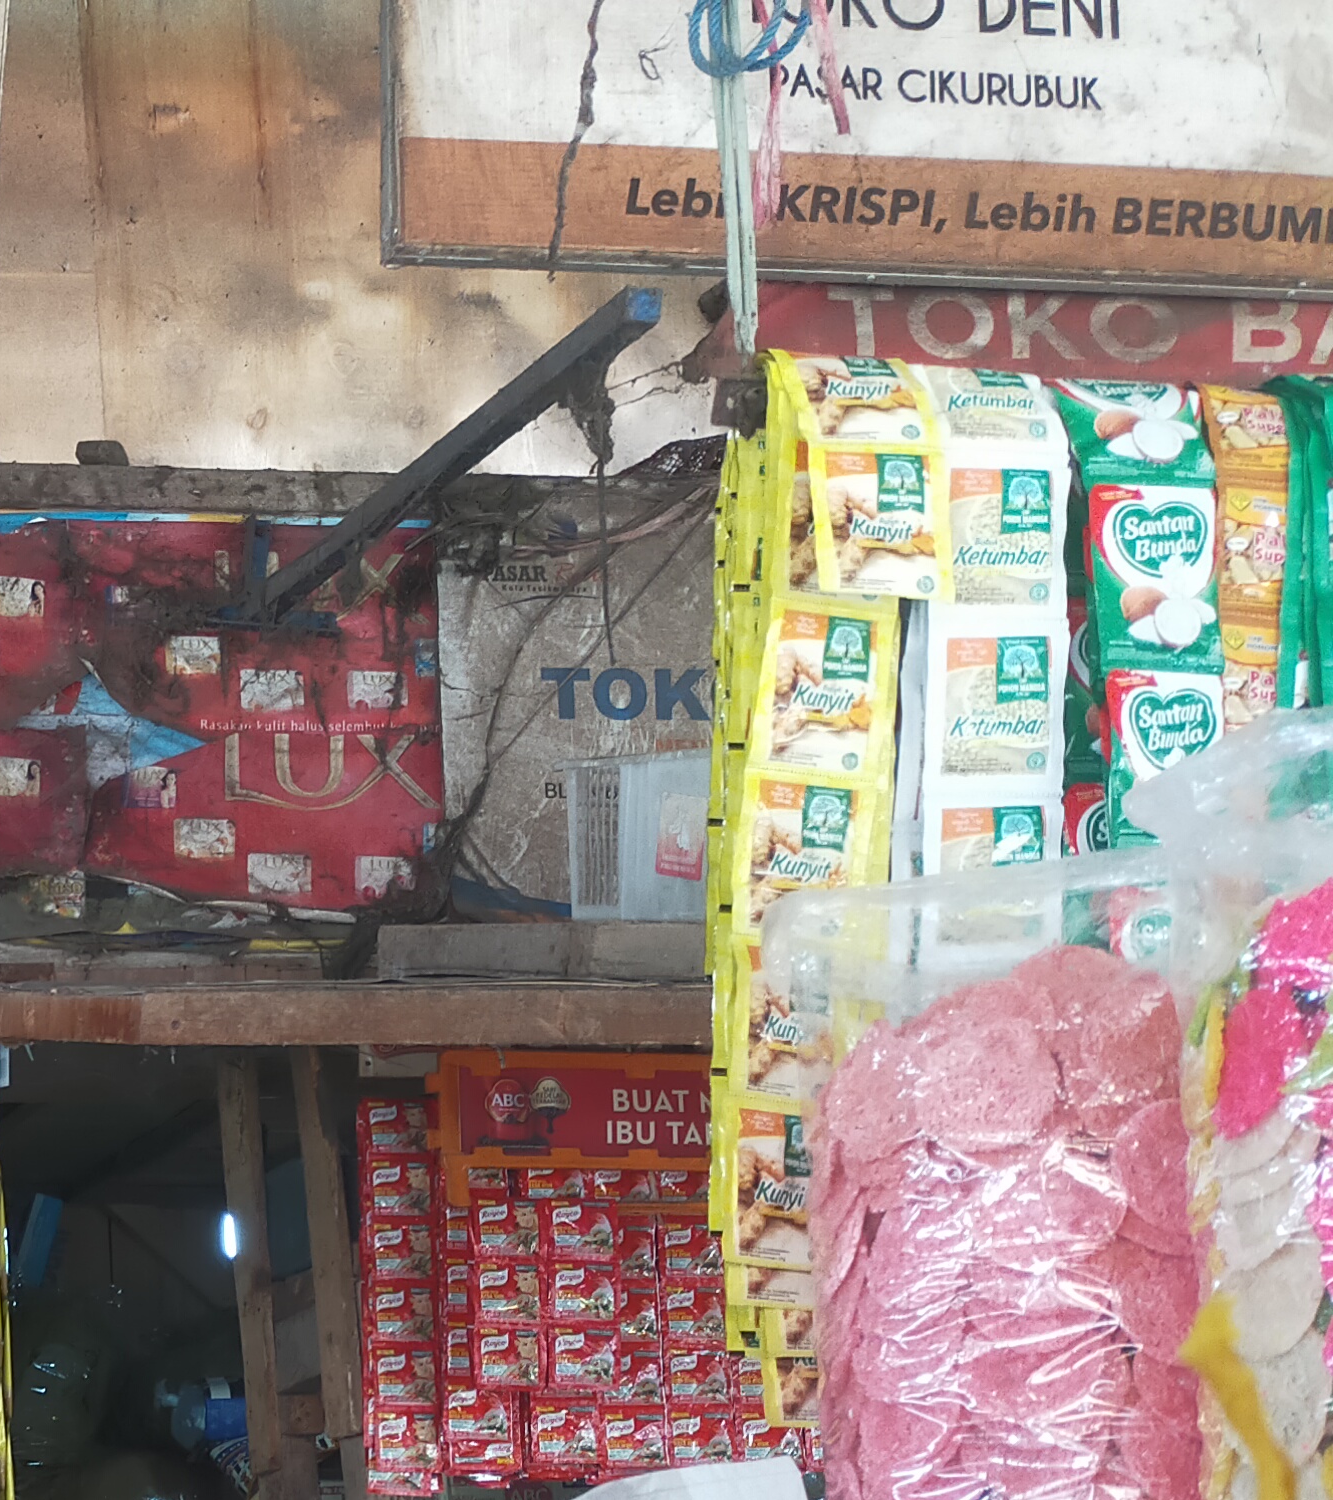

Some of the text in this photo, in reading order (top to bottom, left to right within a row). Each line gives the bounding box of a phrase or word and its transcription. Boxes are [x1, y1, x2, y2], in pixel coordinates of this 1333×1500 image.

[897, 69, 1102, 110] CIKURUBUK
[626, 178, 1333, 244] Leb KRISPI, Lebih BERBUM
[826, 289, 1183, 368] TOKO
[827, 381, 892, 399] Kunyit
[947, 393, 1034, 411] Ketumbar
[853, 517, 912, 543] Kunyit
[1123, 514, 1195, 539] Santan
[953, 545, 1049, 566] Ketumbar
[1135, 536, 1197, 562] Bunda
[541, 667, 714, 721] TOK
[793, 684, 854, 715] Kunyit
[1138, 702, 1204, 729] Santan
[1148, 723, 1206, 751] Bunda
[224, 733, 441, 811] LUX
[770, 853, 831, 884] Kunyit
[491, 1093, 525, 1109] ABC
[612, 1089, 689, 1113] BUAT
[606, 1120, 655, 1145] IBU
[755, 1179, 807, 1210] Kunyi
[481, 1209, 506, 1219] Royco
[555, 1209, 580, 1219] Royco
[449, 1269, 468, 1279] Roy
[558, 1273, 583, 1284] Royco
[450, 1331, 467, 1342] Roy
[484, 1338, 507, 1349] Royco
[609, 1424, 633, 1434] Royco
